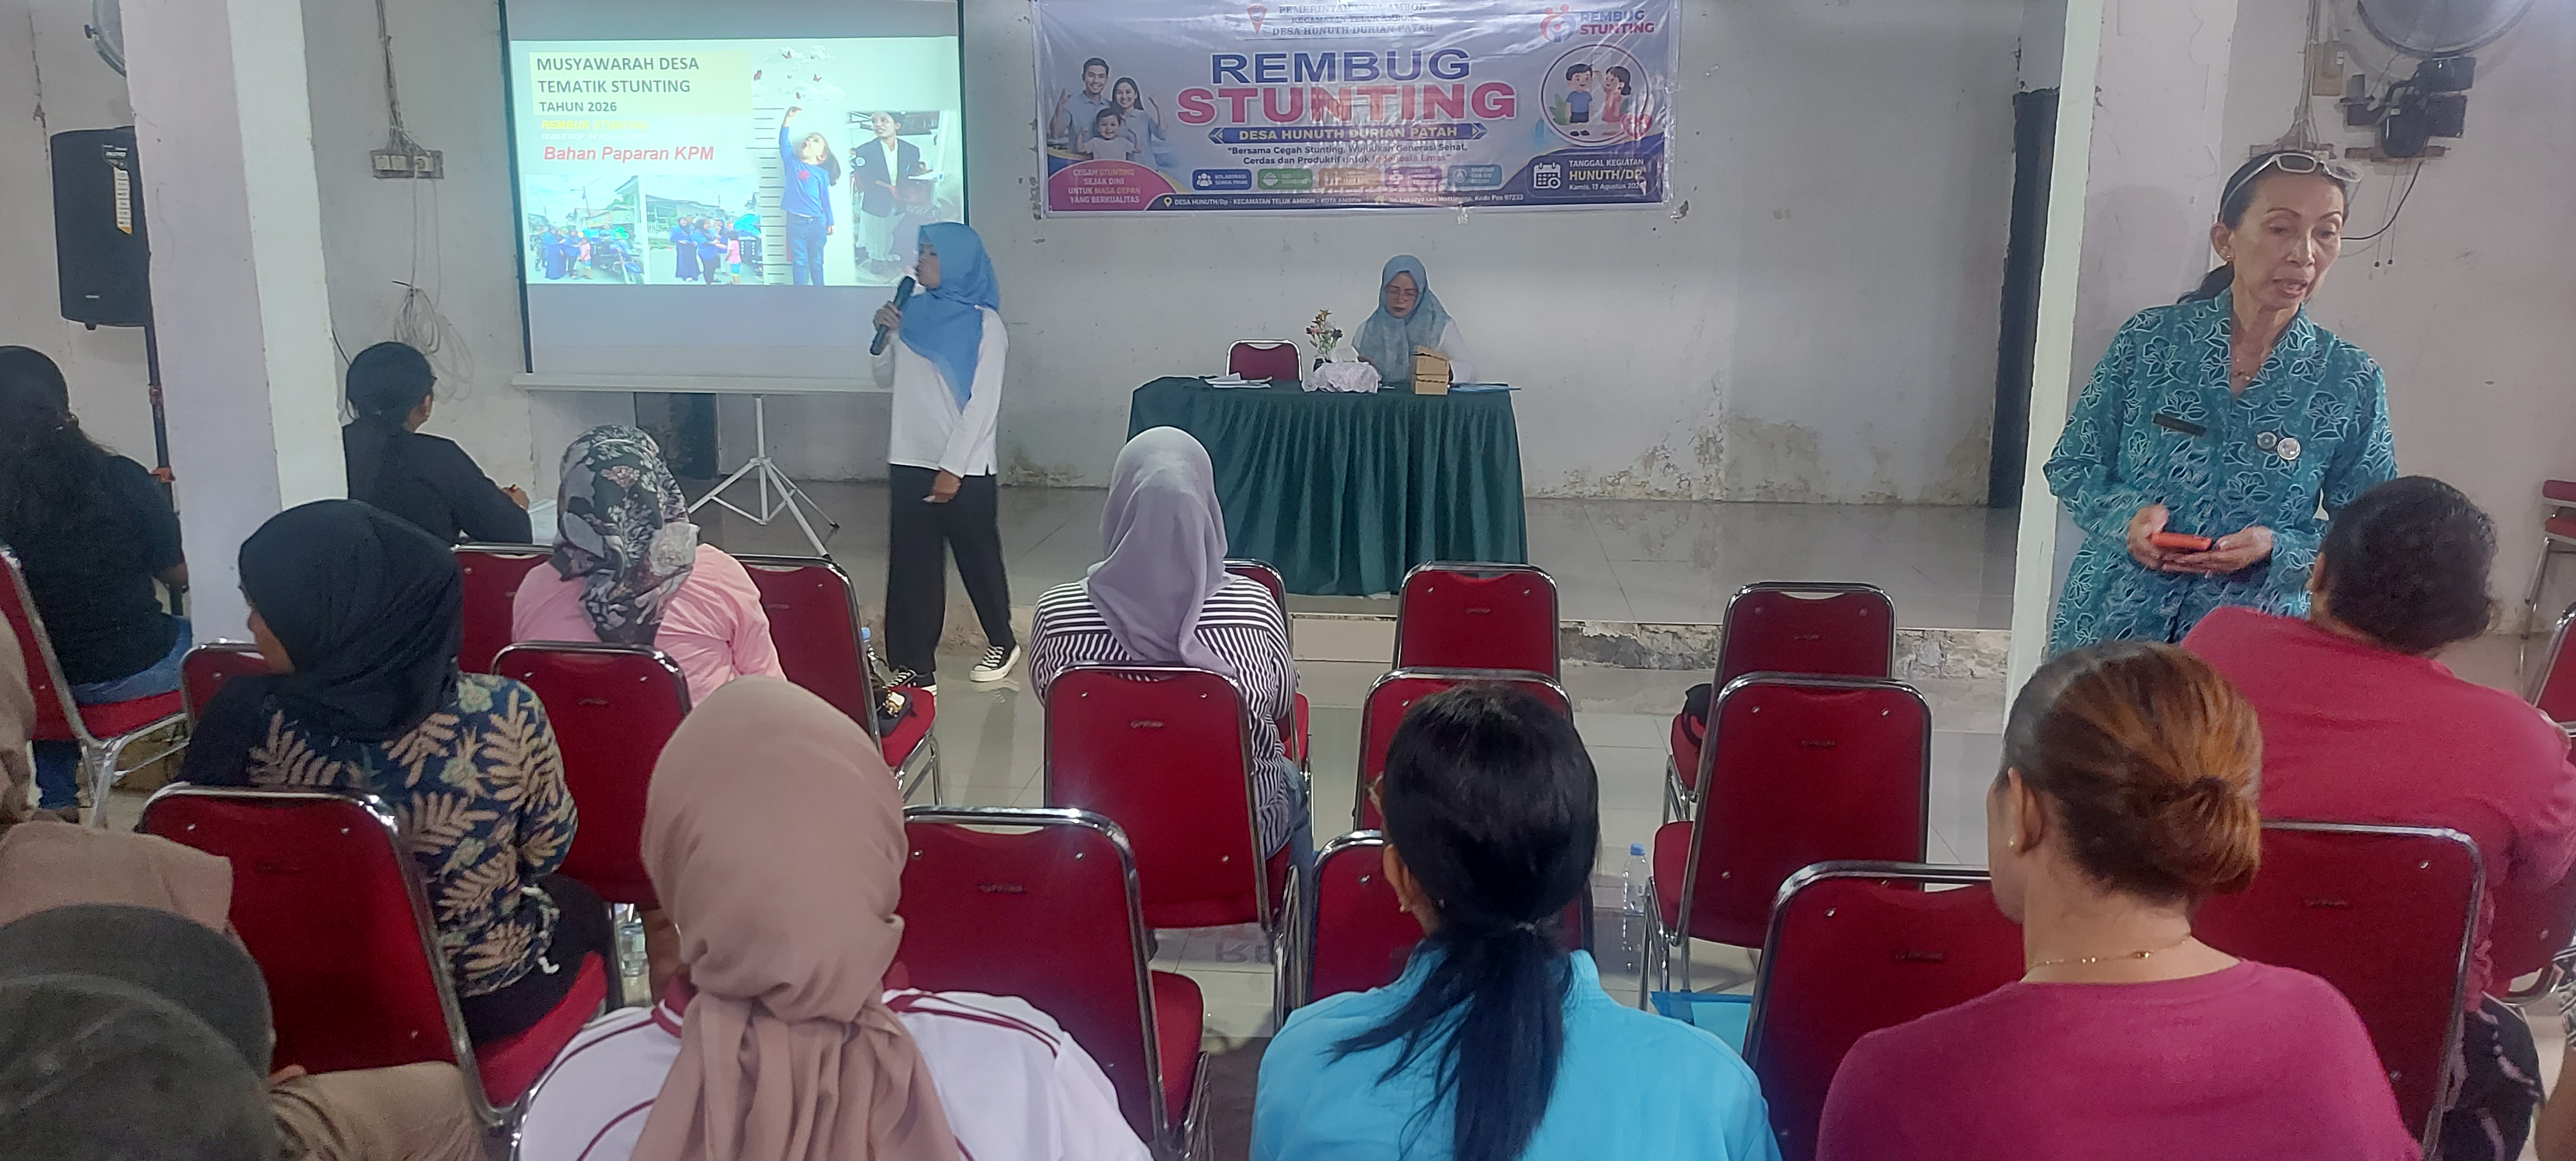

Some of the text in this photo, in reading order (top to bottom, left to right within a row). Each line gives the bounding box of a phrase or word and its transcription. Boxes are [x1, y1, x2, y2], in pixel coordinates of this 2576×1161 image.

[1387, 3, 1427, 12] AMBON
[1580, 10, 1645, 22] REMBUG
[1272, 24, 1433, 36] DESA HUNUTH DURIAN PATAH
[1580, 23, 1655, 35] STUNTING
[537, 57, 700, 70] MUSYAWARAH DESA
[1212, 50, 1470, 84] REMBUG
[538, 80, 691, 93] TEMATIK STUNTING
[539, 101, 617, 112] TAHUN 2026
[1178, 82, 1515, 124] STUNTING
[541, 120, 649, 130] REMBUK STUNTING
[1239, 127, 1457, 140] DESA HUNUTH DURIAN PATAH
[544, 145, 714, 163] Bahan Paparan KPM
[1227, 146, 1271, 155] "Bersama
[1274, 145, 1302, 155] Cegah
[1348, 144, 1394, 154] Wujudkan
[1396, 143, 1436, 152] Generasi
[1438, 143, 1467, 152] Sehat,
[1297, 155, 1340, 164] Produktif
[1421, 154, 1451, 162] Emas"
[1606, 158, 1644, 167] KEGIATAN
[1569, 169, 1643, 181] HUNUTH/DP
